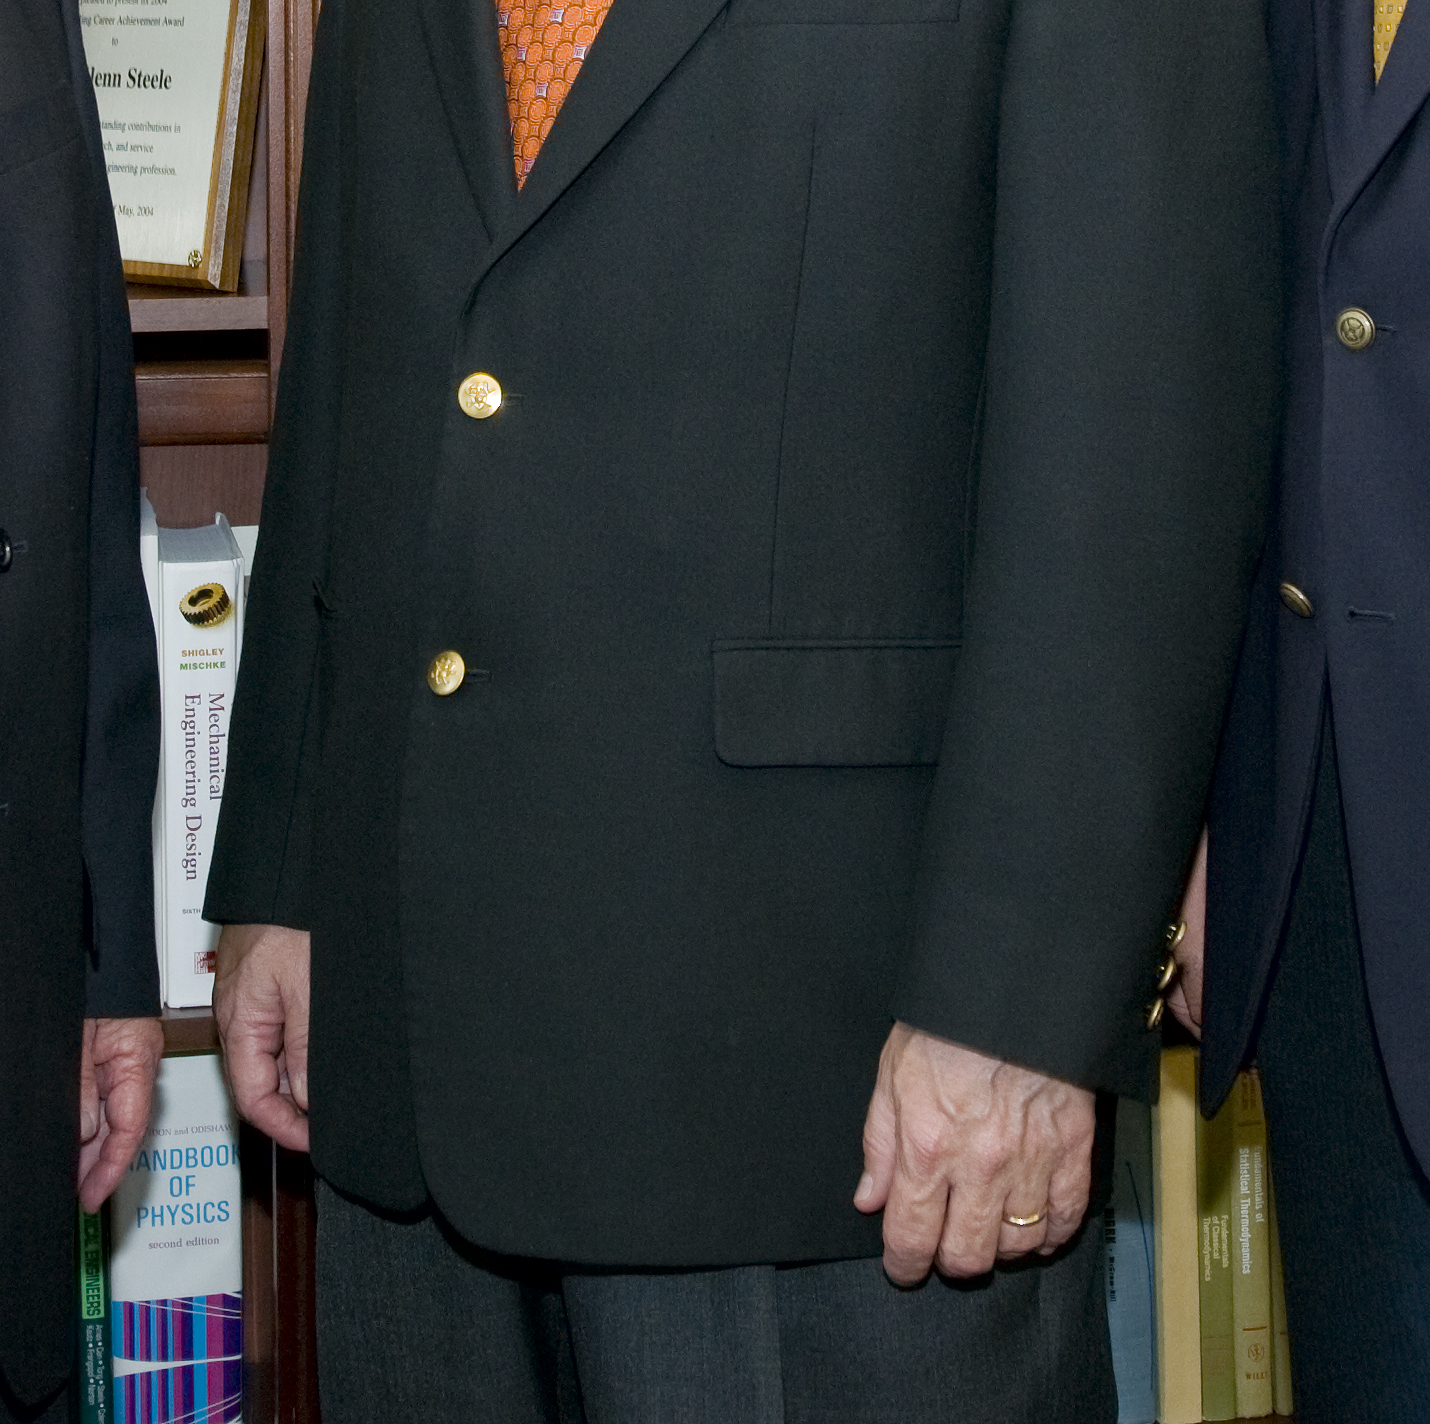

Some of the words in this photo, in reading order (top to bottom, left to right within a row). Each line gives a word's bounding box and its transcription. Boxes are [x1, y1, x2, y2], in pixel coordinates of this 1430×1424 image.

[111, 37, 119, 46] to
[117, 204, 135, 218] May,
[136, 205, 154, 217] 2004
[179, 660, 226, 671] MISCHKE
[181, 648, 224, 658] SHIGLEY
[181, 693, 202, 808] Engineering
[208, 692, 226, 801] Mechanical
[181, 814, 203, 881] Design
[169, 1174, 196, 1198] OF
[1238, 1147, 1251, 1194] Statistical
[136, 1200, 230, 1229] PHYSICS
[1212, 1215, 1220, 1224] of
[148, 1238, 183, 1250] second
[186, 1236, 220, 1247] edition
[1202, 1217, 1211, 1282] Thermodynamics
[1212, 1226, 1220, 1260] Classical
[1221, 1214, 1229, 1268] Fundamentals
[1239, 1197, 1253, 1275] Thermodynamics
